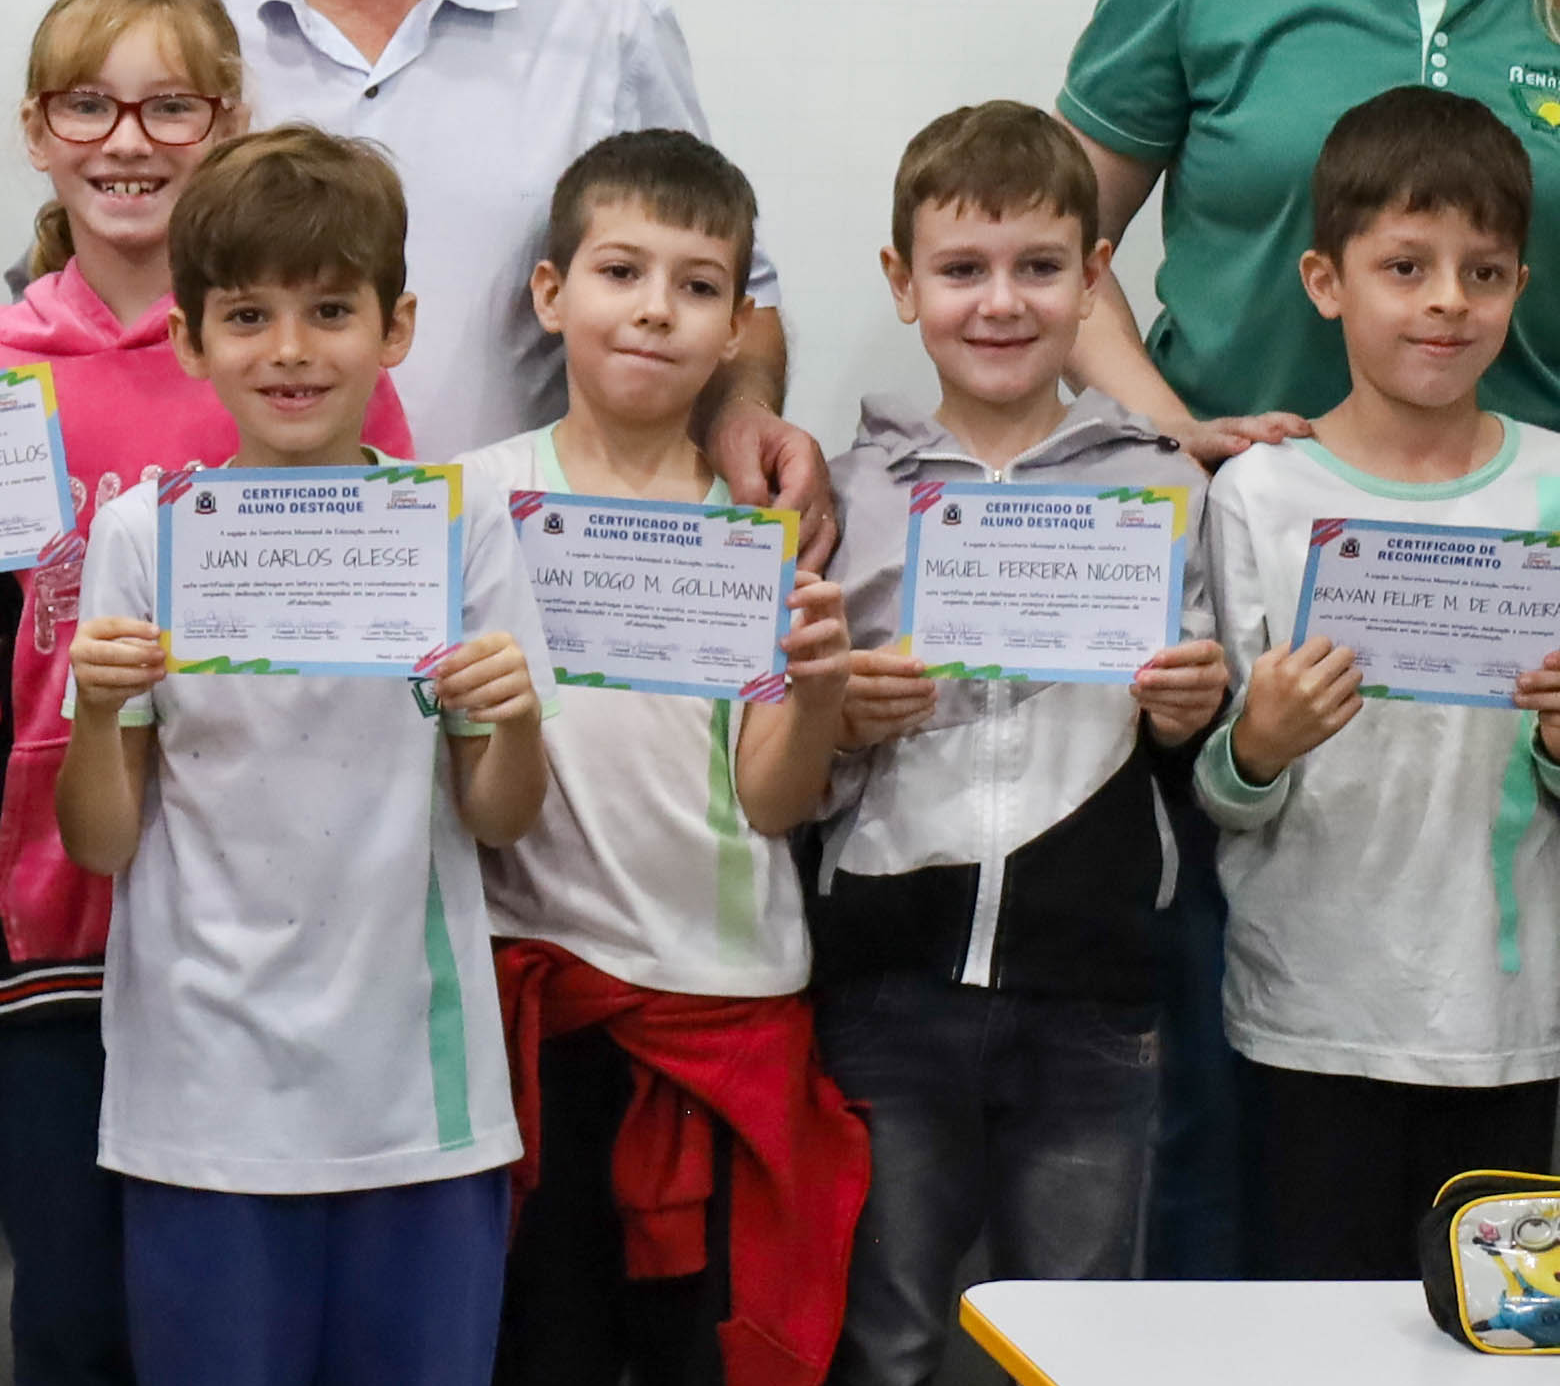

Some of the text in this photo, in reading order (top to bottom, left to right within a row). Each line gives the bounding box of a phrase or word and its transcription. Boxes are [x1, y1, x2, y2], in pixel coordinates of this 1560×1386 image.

[243, 487, 339, 500] CERTIFICADO
[200, 548, 420, 570] JUAN CARLOS GLESSE
[925, 559, 1161, 583] MIGUEL FERREIRA NICODEM
[583, 570, 773, 602] DIOGO GOLLMANN
[1313, 587, 1376, 605] BRAYAN
[1383, 590, 1434, 609] FELIPE
[1470, 596, 1489, 614] DE
